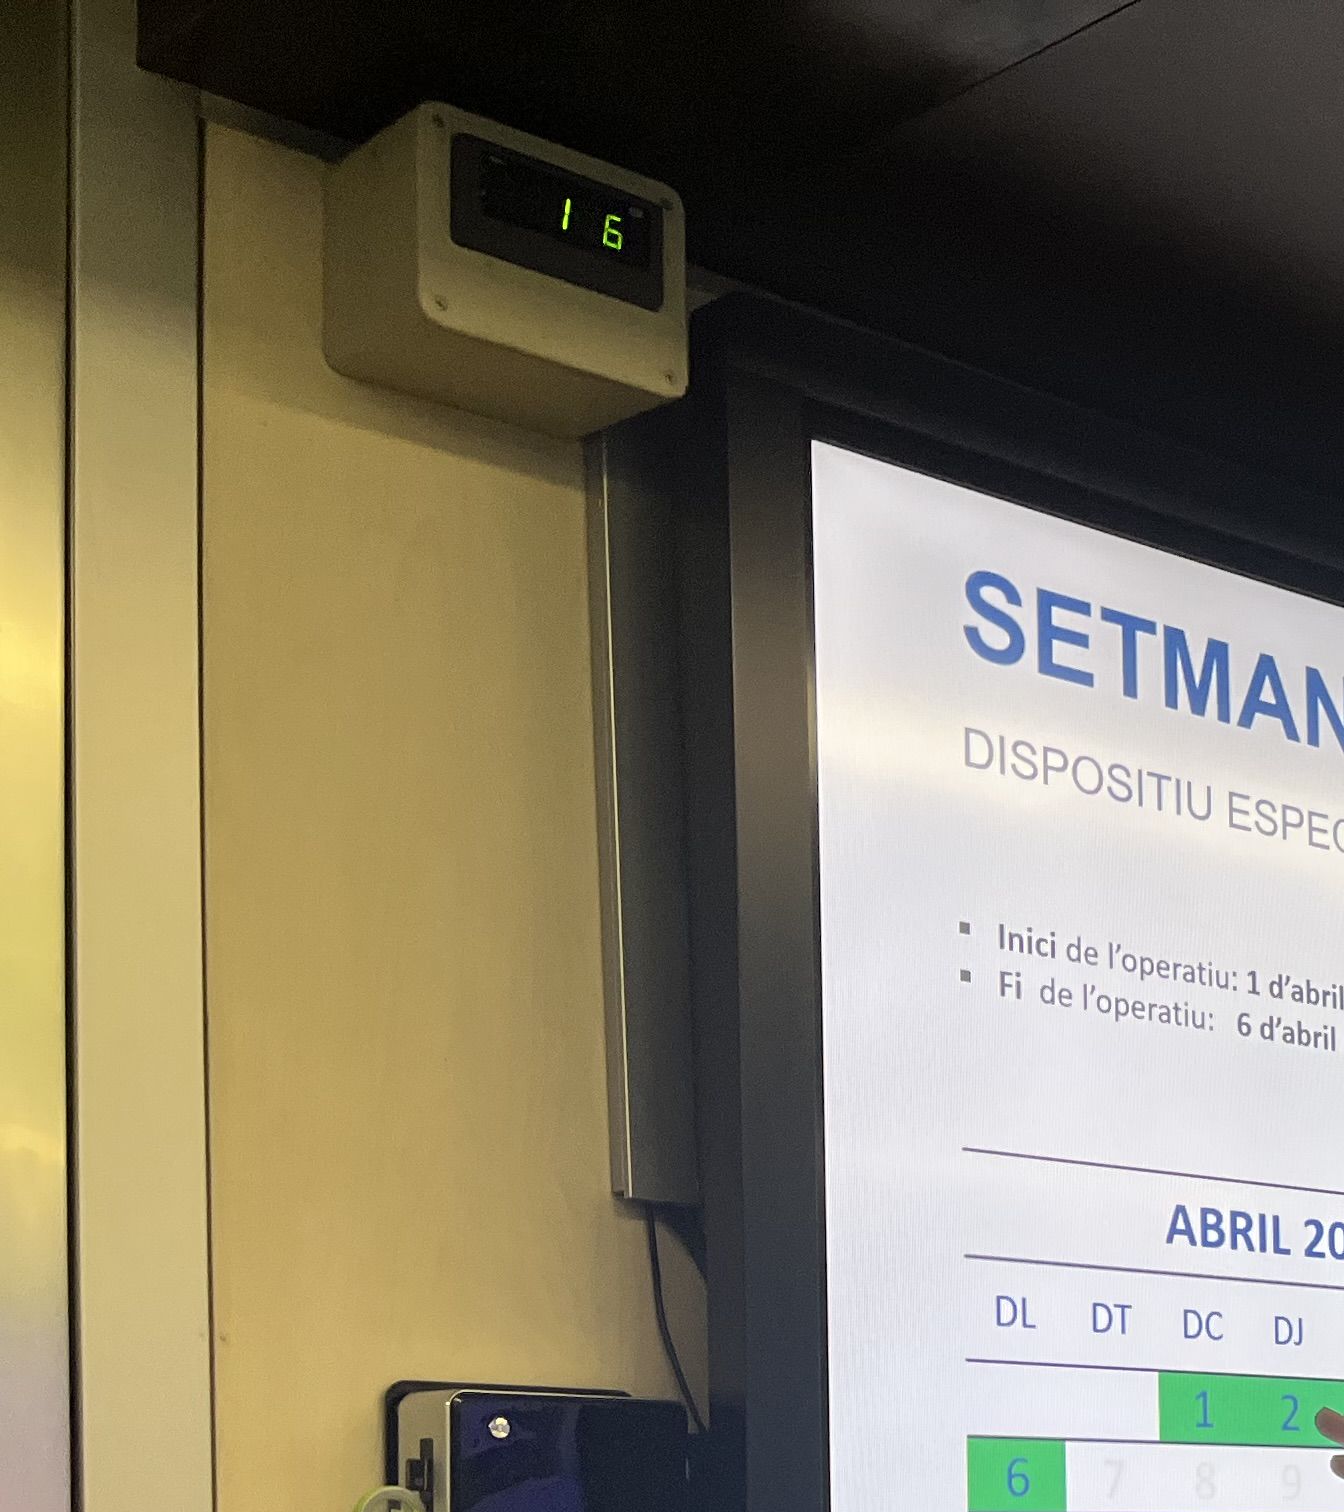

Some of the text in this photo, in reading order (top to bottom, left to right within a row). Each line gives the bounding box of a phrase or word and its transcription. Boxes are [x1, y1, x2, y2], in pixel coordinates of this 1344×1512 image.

[965, 727, 1211, 820] DISPOSITIU
[999, 924, 1055, 958] Inici
[1067, 937, 1098, 965] de
[1248, 971, 1260, 995] 1
[1269, 974, 1344, 1010] d'abril
[1000, 971, 1021, 999] Fi
[1040, 978, 1072, 1007] de
[1238, 1013, 1251, 1036] 6
[1260, 1016, 1335, 1051] d'abril
[1166, 1205, 1291, 1255] ABRIL
[996, 1296, 1036, 1328] DL
[1093, 1303, 1132, 1334] DT
[1184, 1309, 1223, 1340] DC
[1275, 1316, 1302, 1345] DJ
[1195, 1391, 1214, 1427] 1
[1281, 1394, 1299, 1432] 2
[1006, 1457, 1030, 1497] 6
[1104, 1460, 1125, 1499] 7
[1194, 1462, 1216, 1499] 8
[1282, 1464, 1301, 1501] 9
